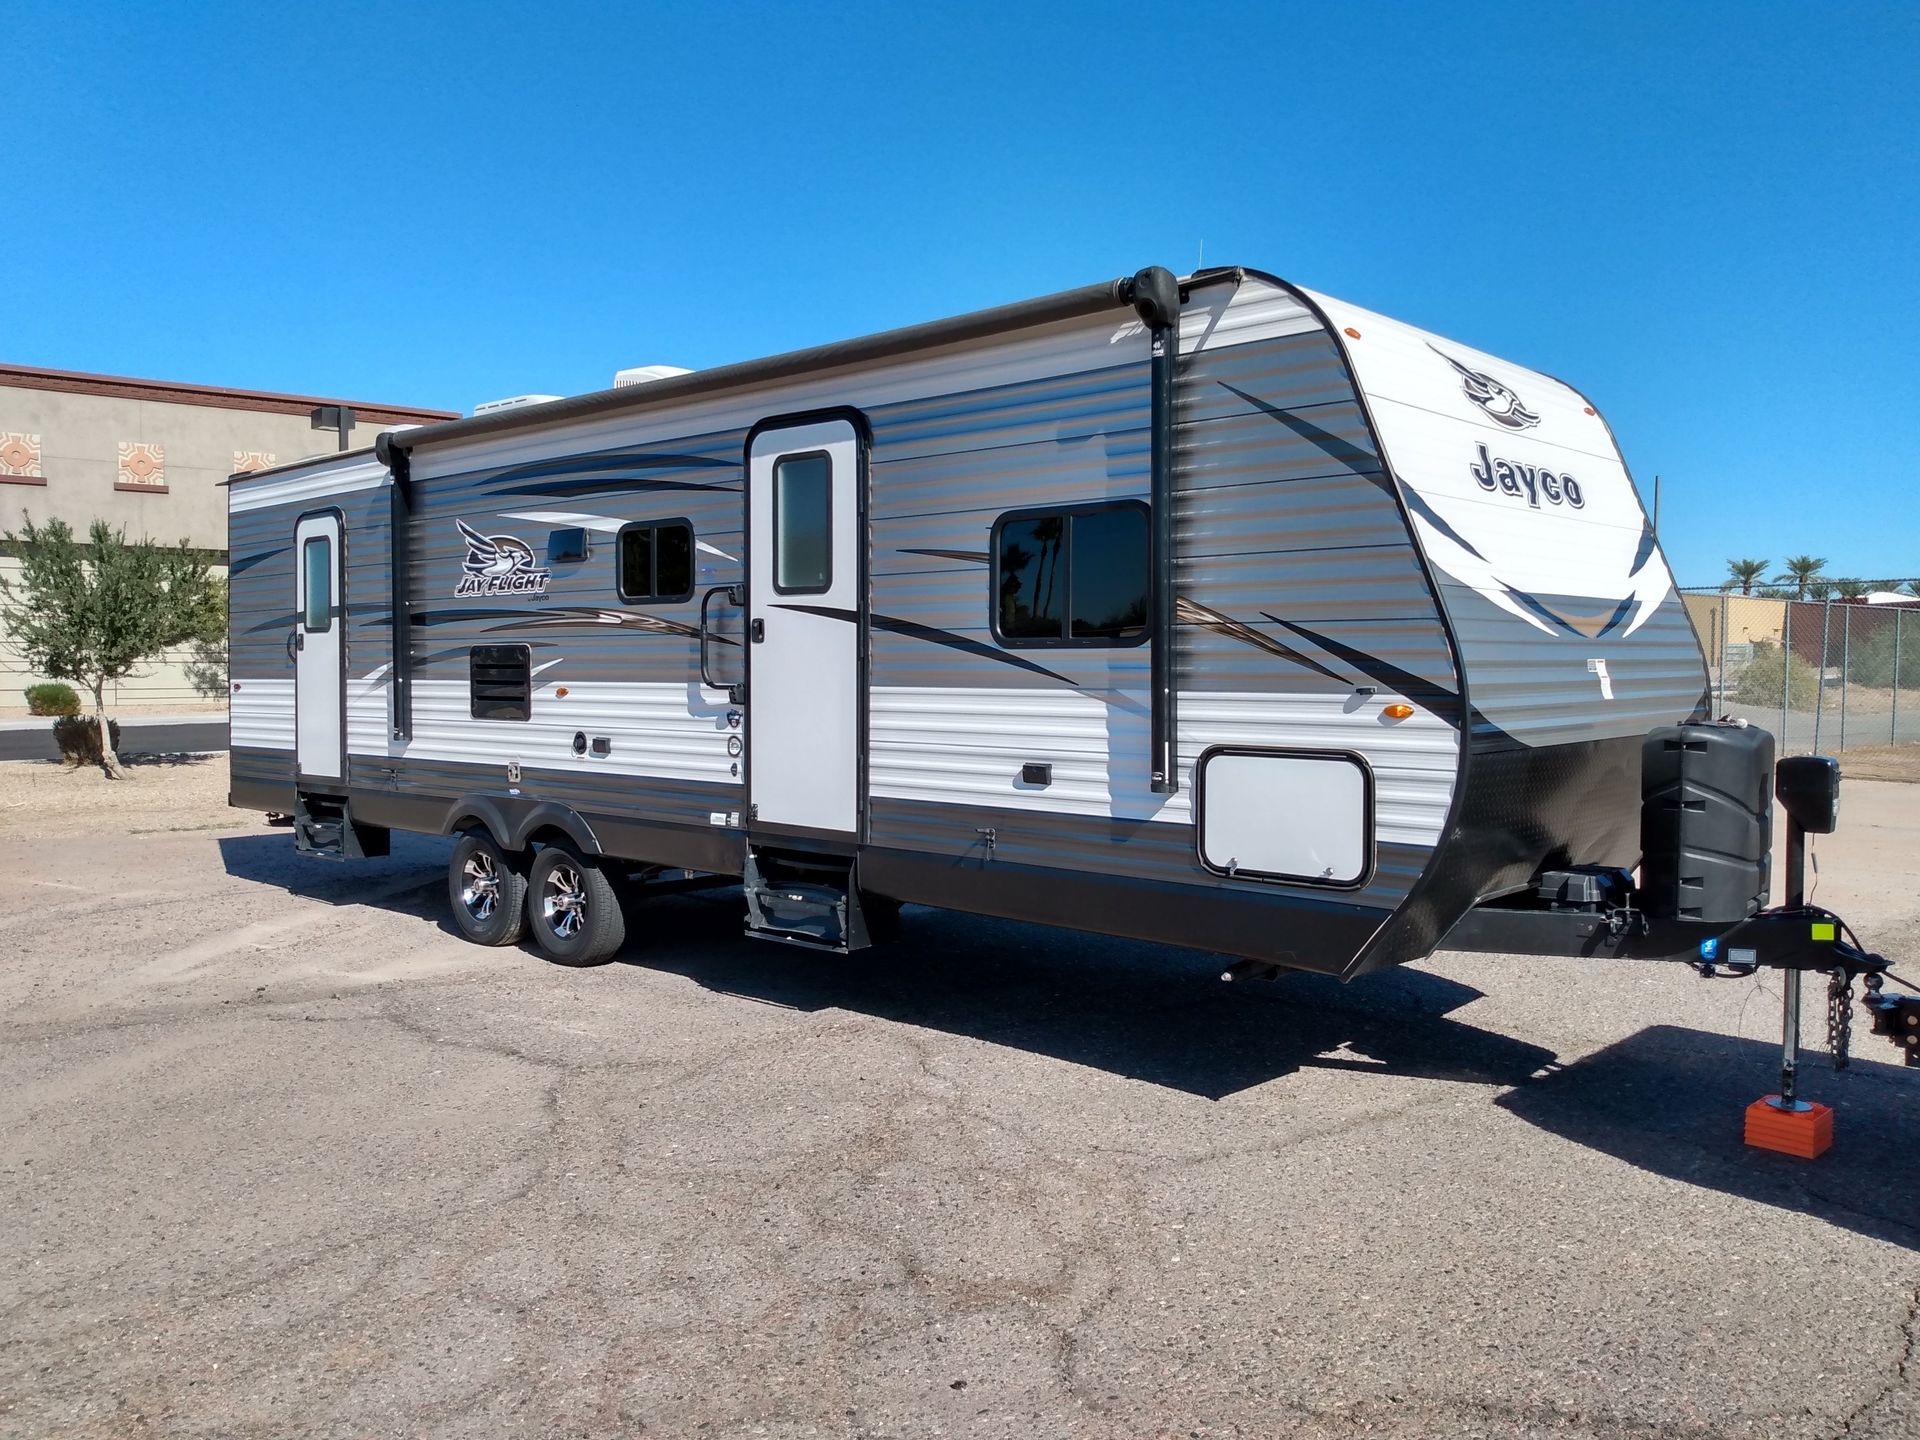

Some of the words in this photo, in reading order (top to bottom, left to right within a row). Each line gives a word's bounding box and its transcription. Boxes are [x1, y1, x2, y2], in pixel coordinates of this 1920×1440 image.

[1470, 441, 1585, 509] Jayco
[456, 576, 487, 597] JAY
[486, 573, 551, 595] FLIGHT
